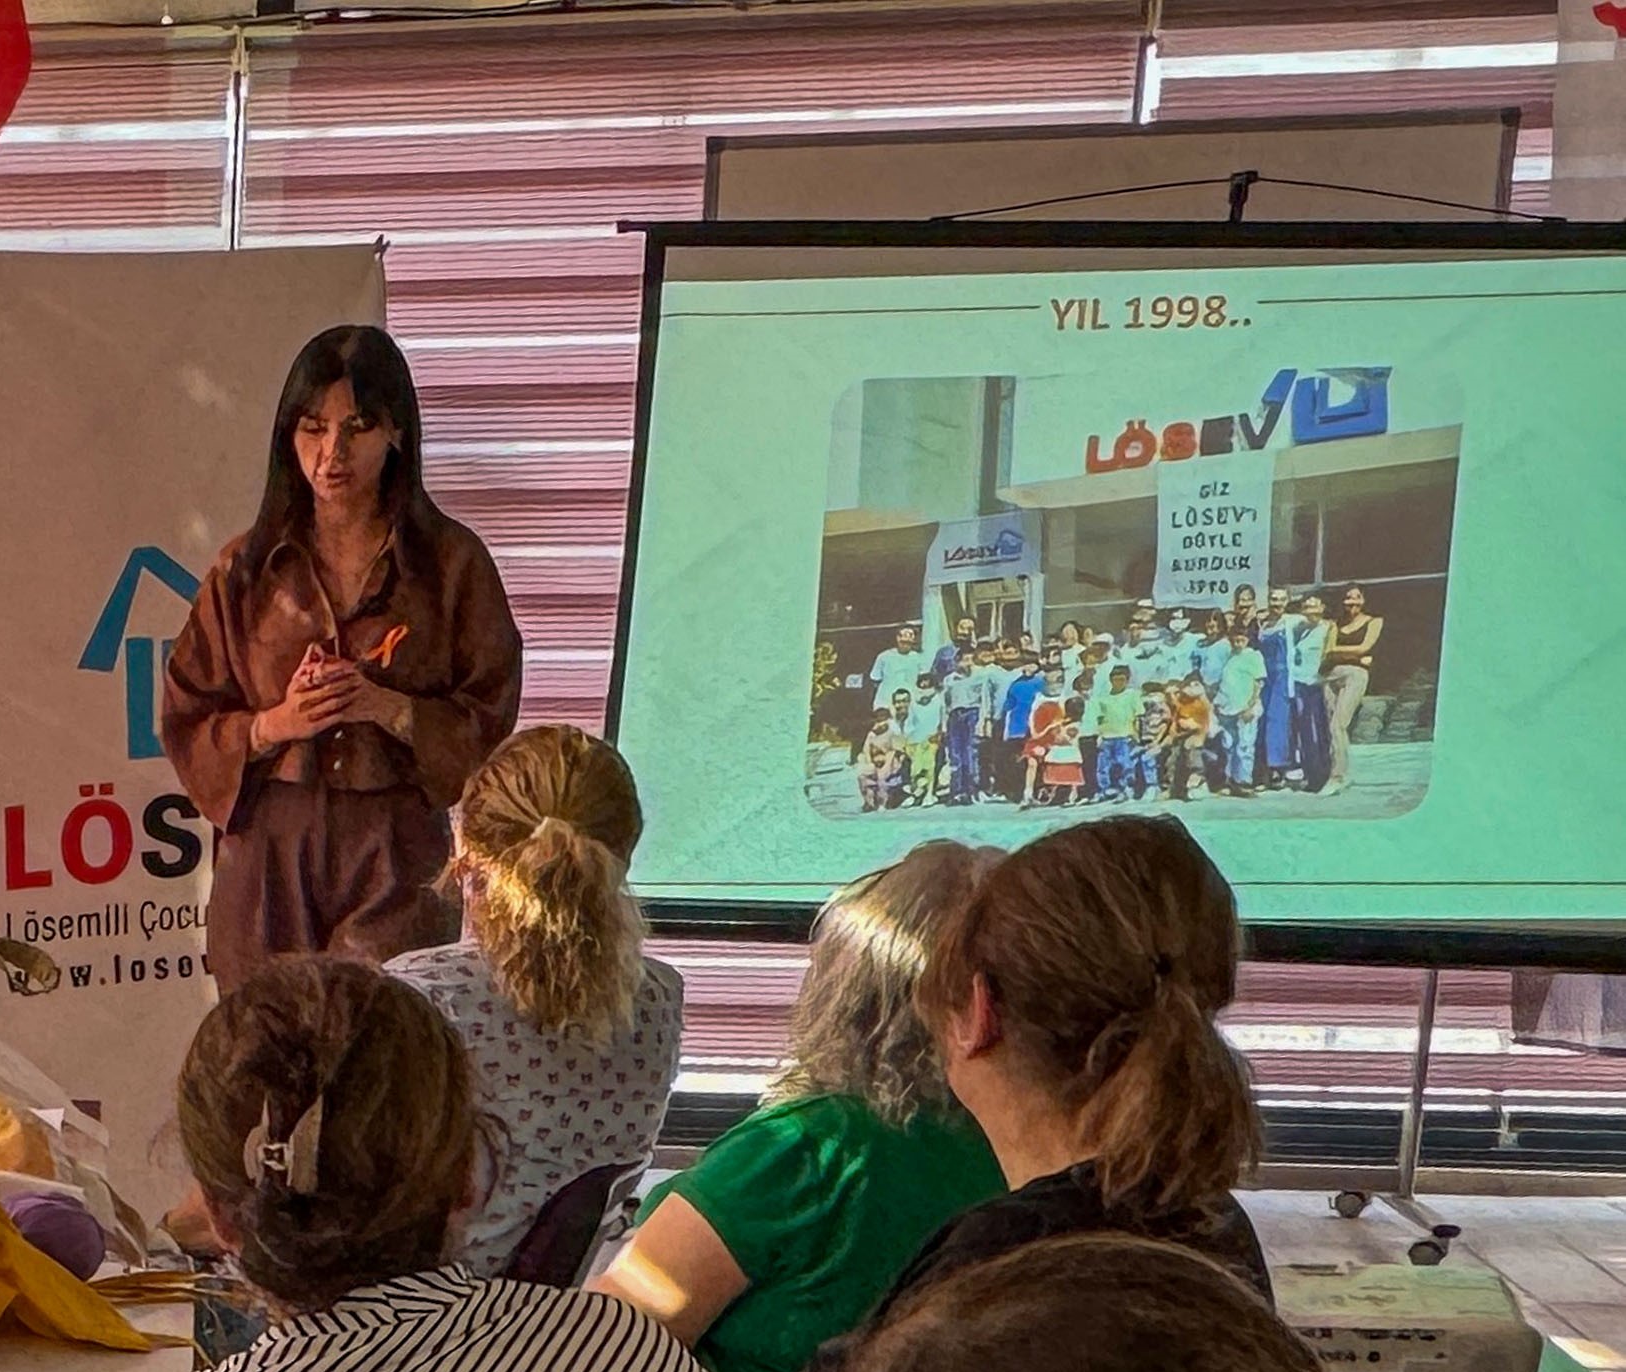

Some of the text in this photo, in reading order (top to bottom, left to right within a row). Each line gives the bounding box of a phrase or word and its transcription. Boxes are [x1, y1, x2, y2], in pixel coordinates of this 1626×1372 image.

[1050, 298, 1111, 331] YIL
[4, 782, 204, 890] LÖS
[139, 900, 210, 941] Çocu
